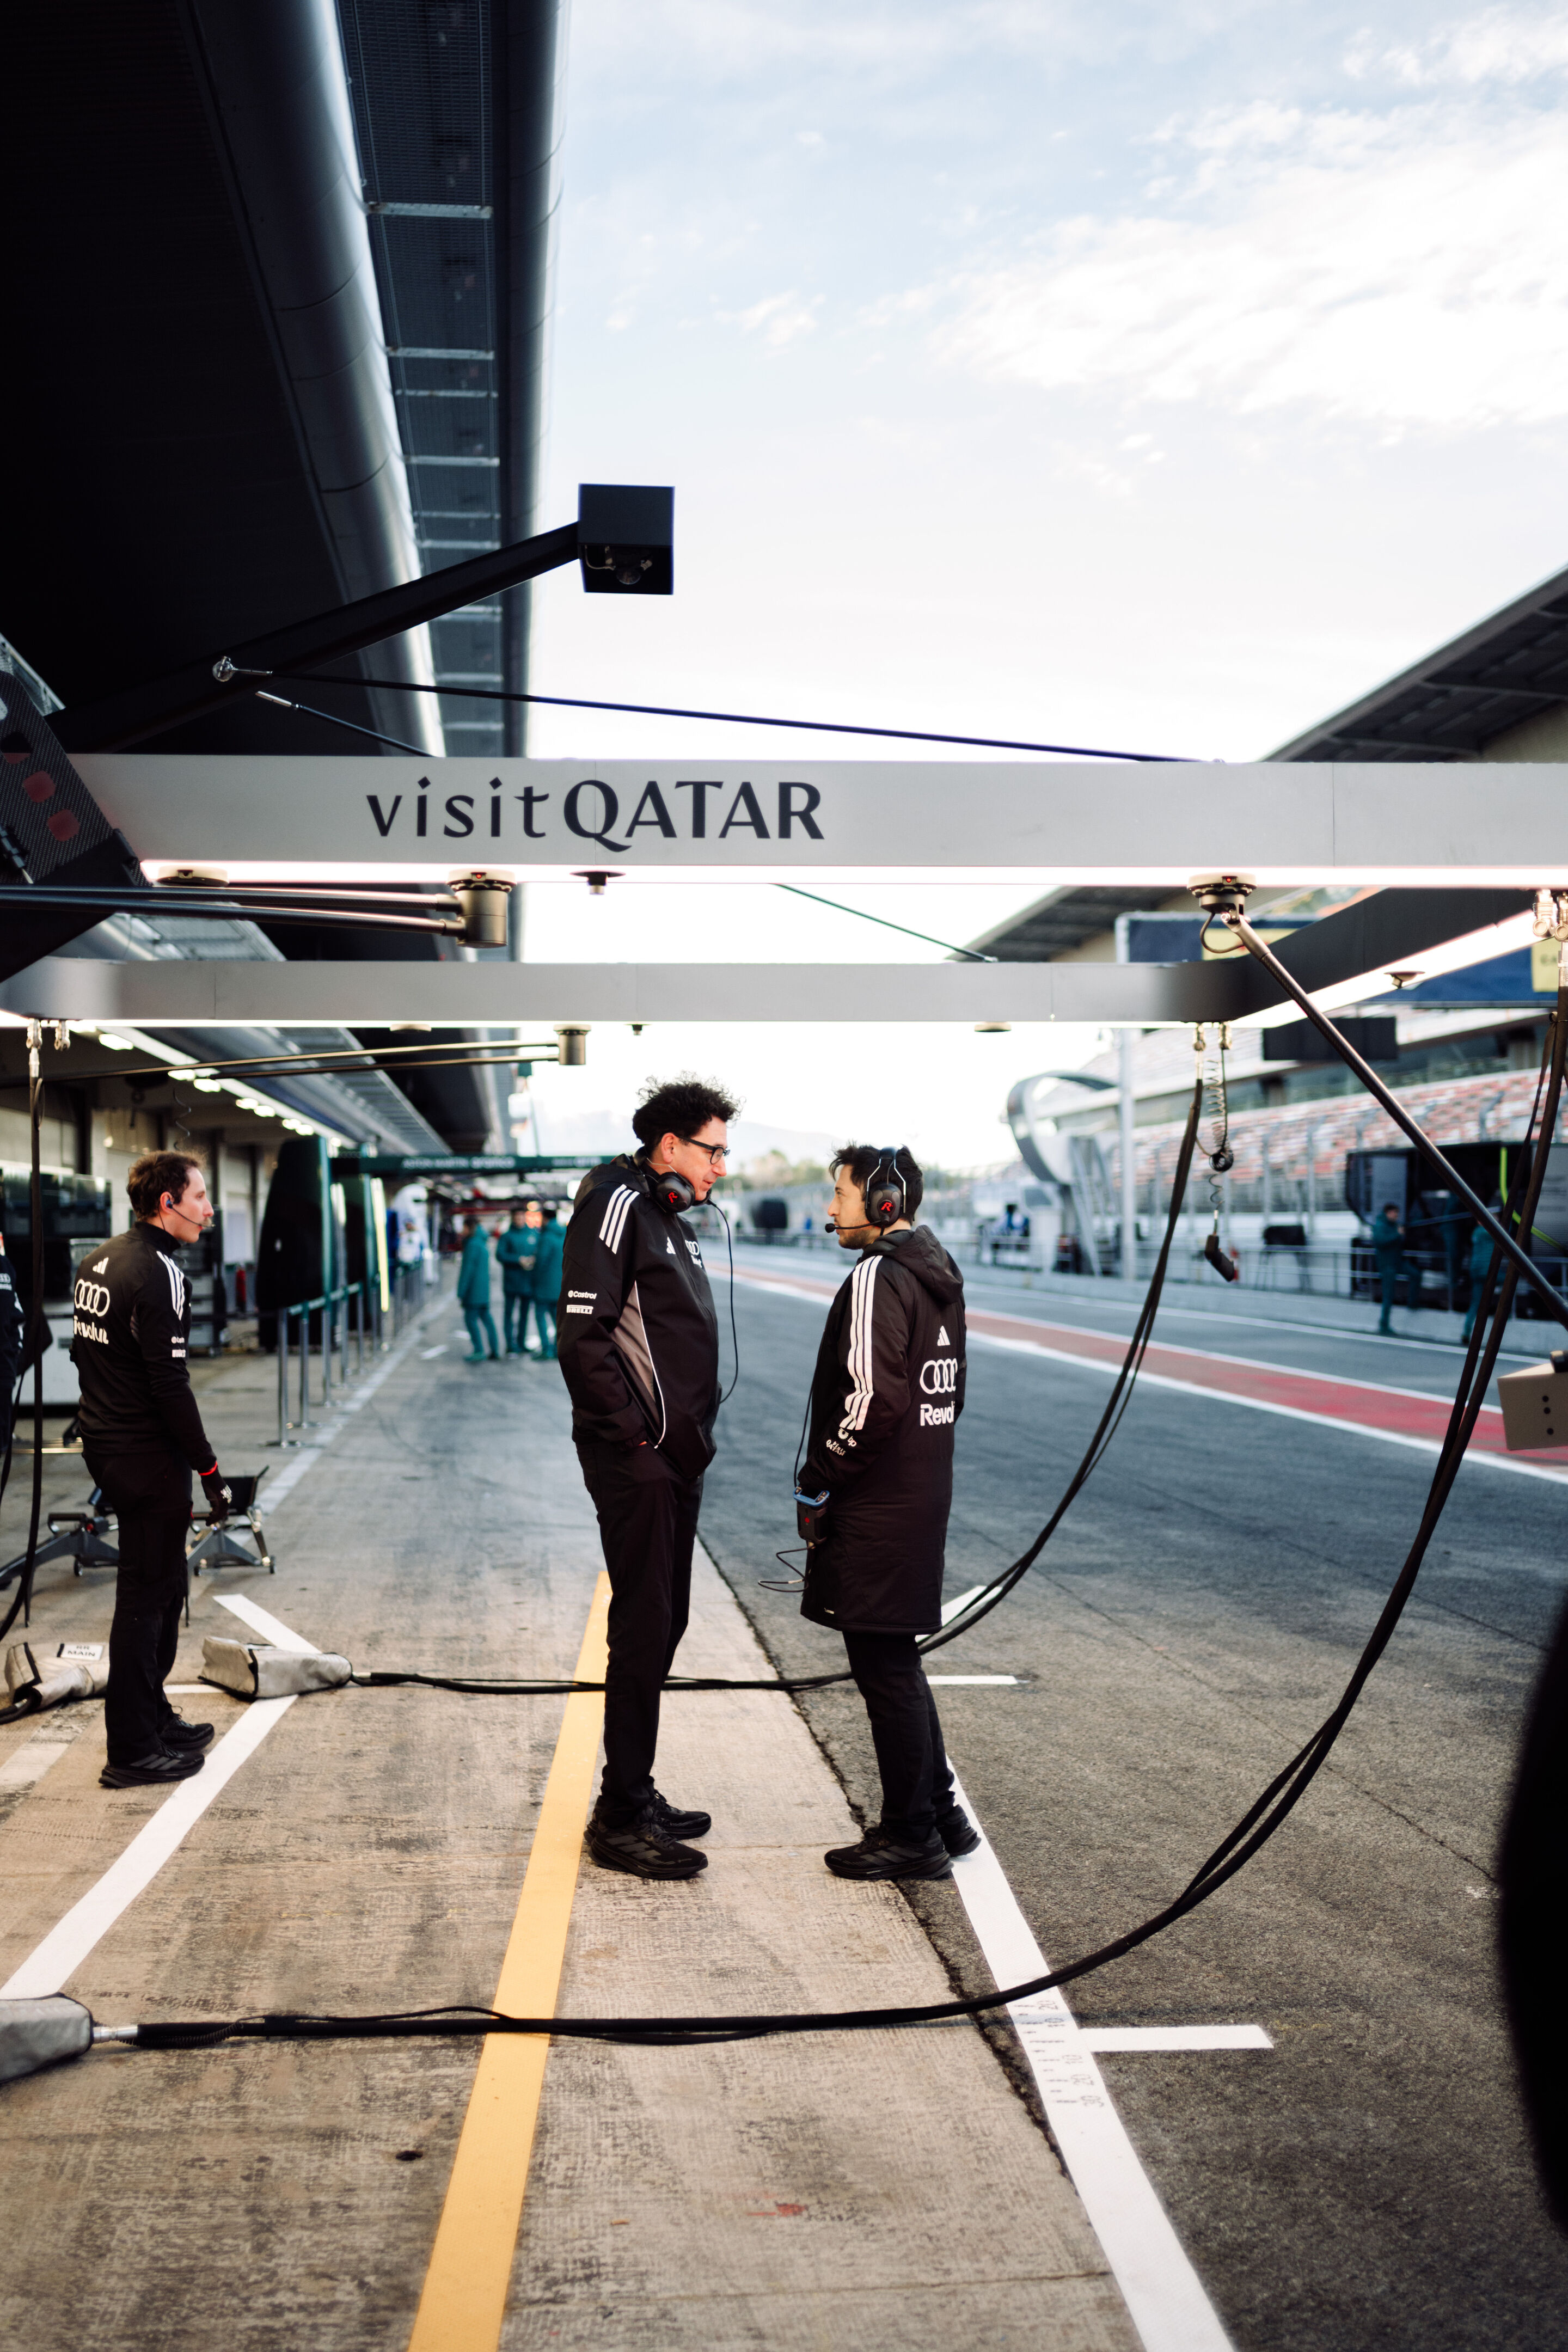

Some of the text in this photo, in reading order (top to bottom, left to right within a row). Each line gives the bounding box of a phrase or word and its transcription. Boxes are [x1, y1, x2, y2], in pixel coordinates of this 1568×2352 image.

[366, 776, 825, 853] visitQATAR
[573, 1291, 597, 1299] Castrol
[920, 1401, 955, 1426] Revol
[847, 1436, 857, 1447] bp
